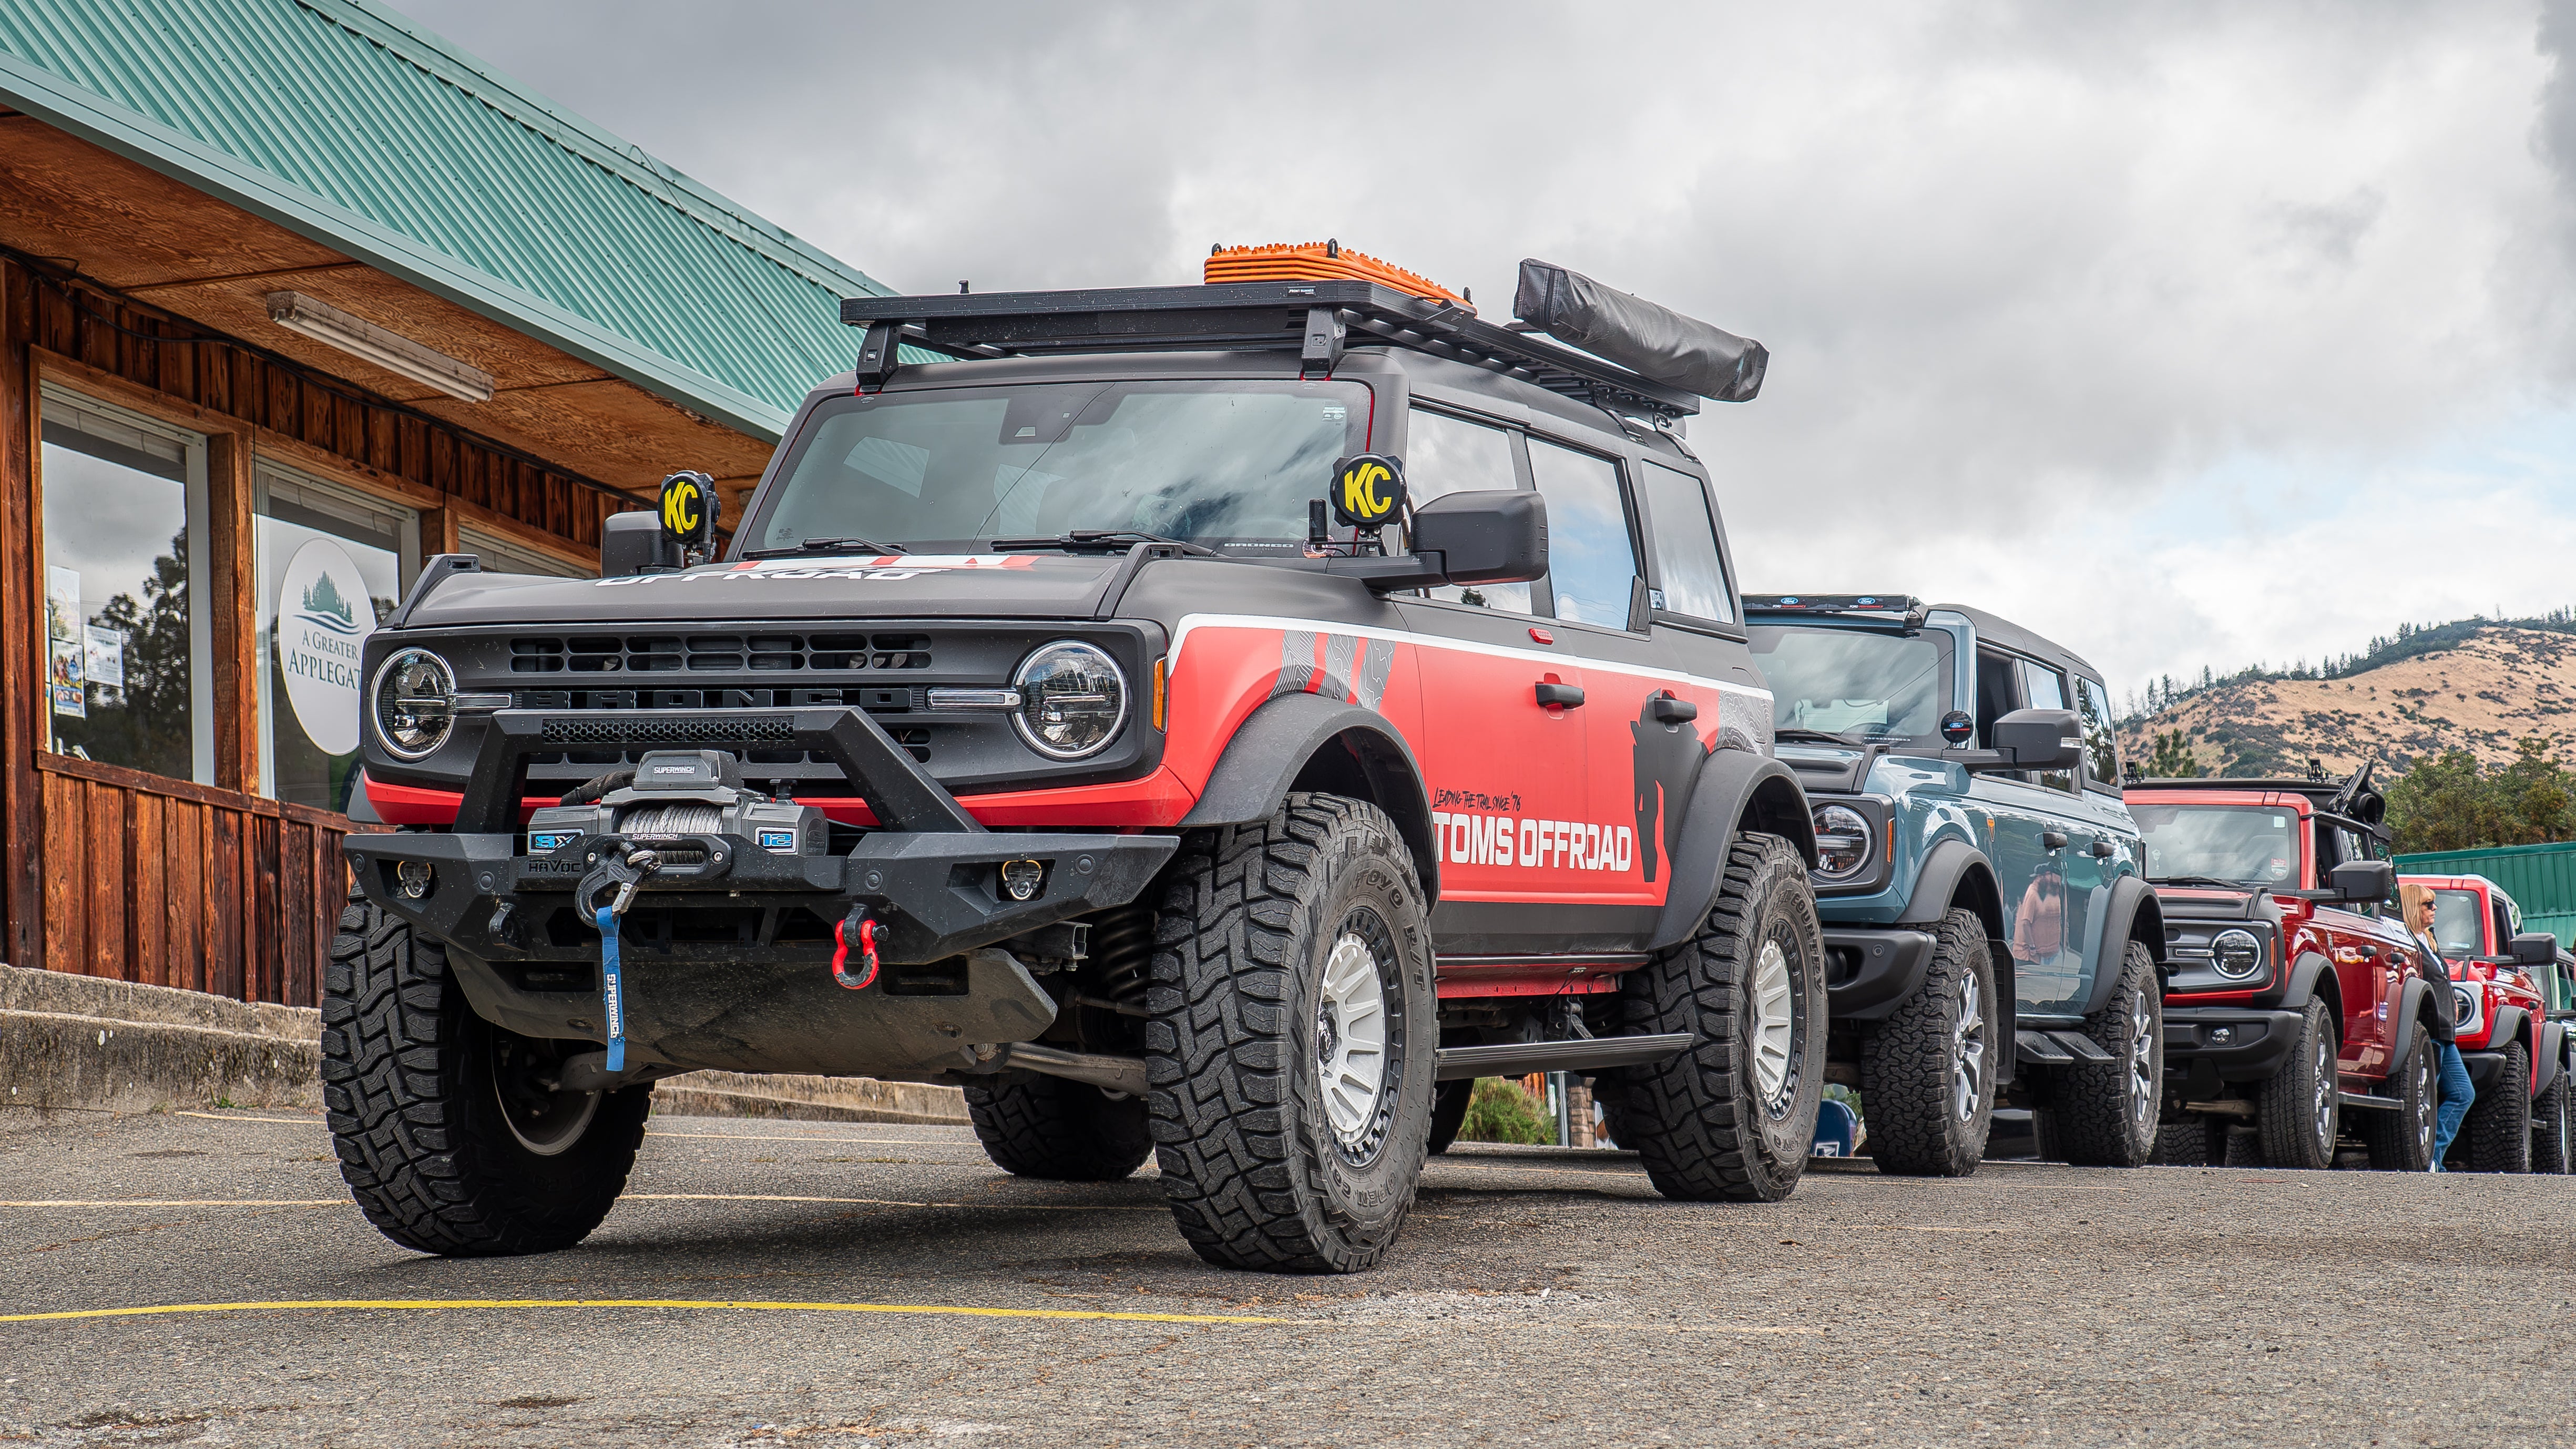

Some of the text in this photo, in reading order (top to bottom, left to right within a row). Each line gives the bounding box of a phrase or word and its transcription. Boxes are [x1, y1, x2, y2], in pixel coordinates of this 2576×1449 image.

[665, 482, 698, 534] KC
[1345, 463, 1392, 517] KC
[302, 628, 359, 661] A GREATER
[522, 688, 912, 709] BRONCO
[1433, 787, 1463, 808] LEADING
[1462, 791, 1476, 810] THE
[1476, 793, 1491, 811] TRAIL
[1491, 794, 1510, 811] SINCE
[760, 834, 792, 846] 12
[1433, 811, 1632, 872] TOMS OFFROAD
[528, 858, 581, 872] HAVOC
[1355, 868, 1404, 909] TOYO
[1404, 924, 1425, 991] R/T
[1791, 893, 1823, 995] COUNTRY
[606, 974, 620, 1039] SUPERWINCH
